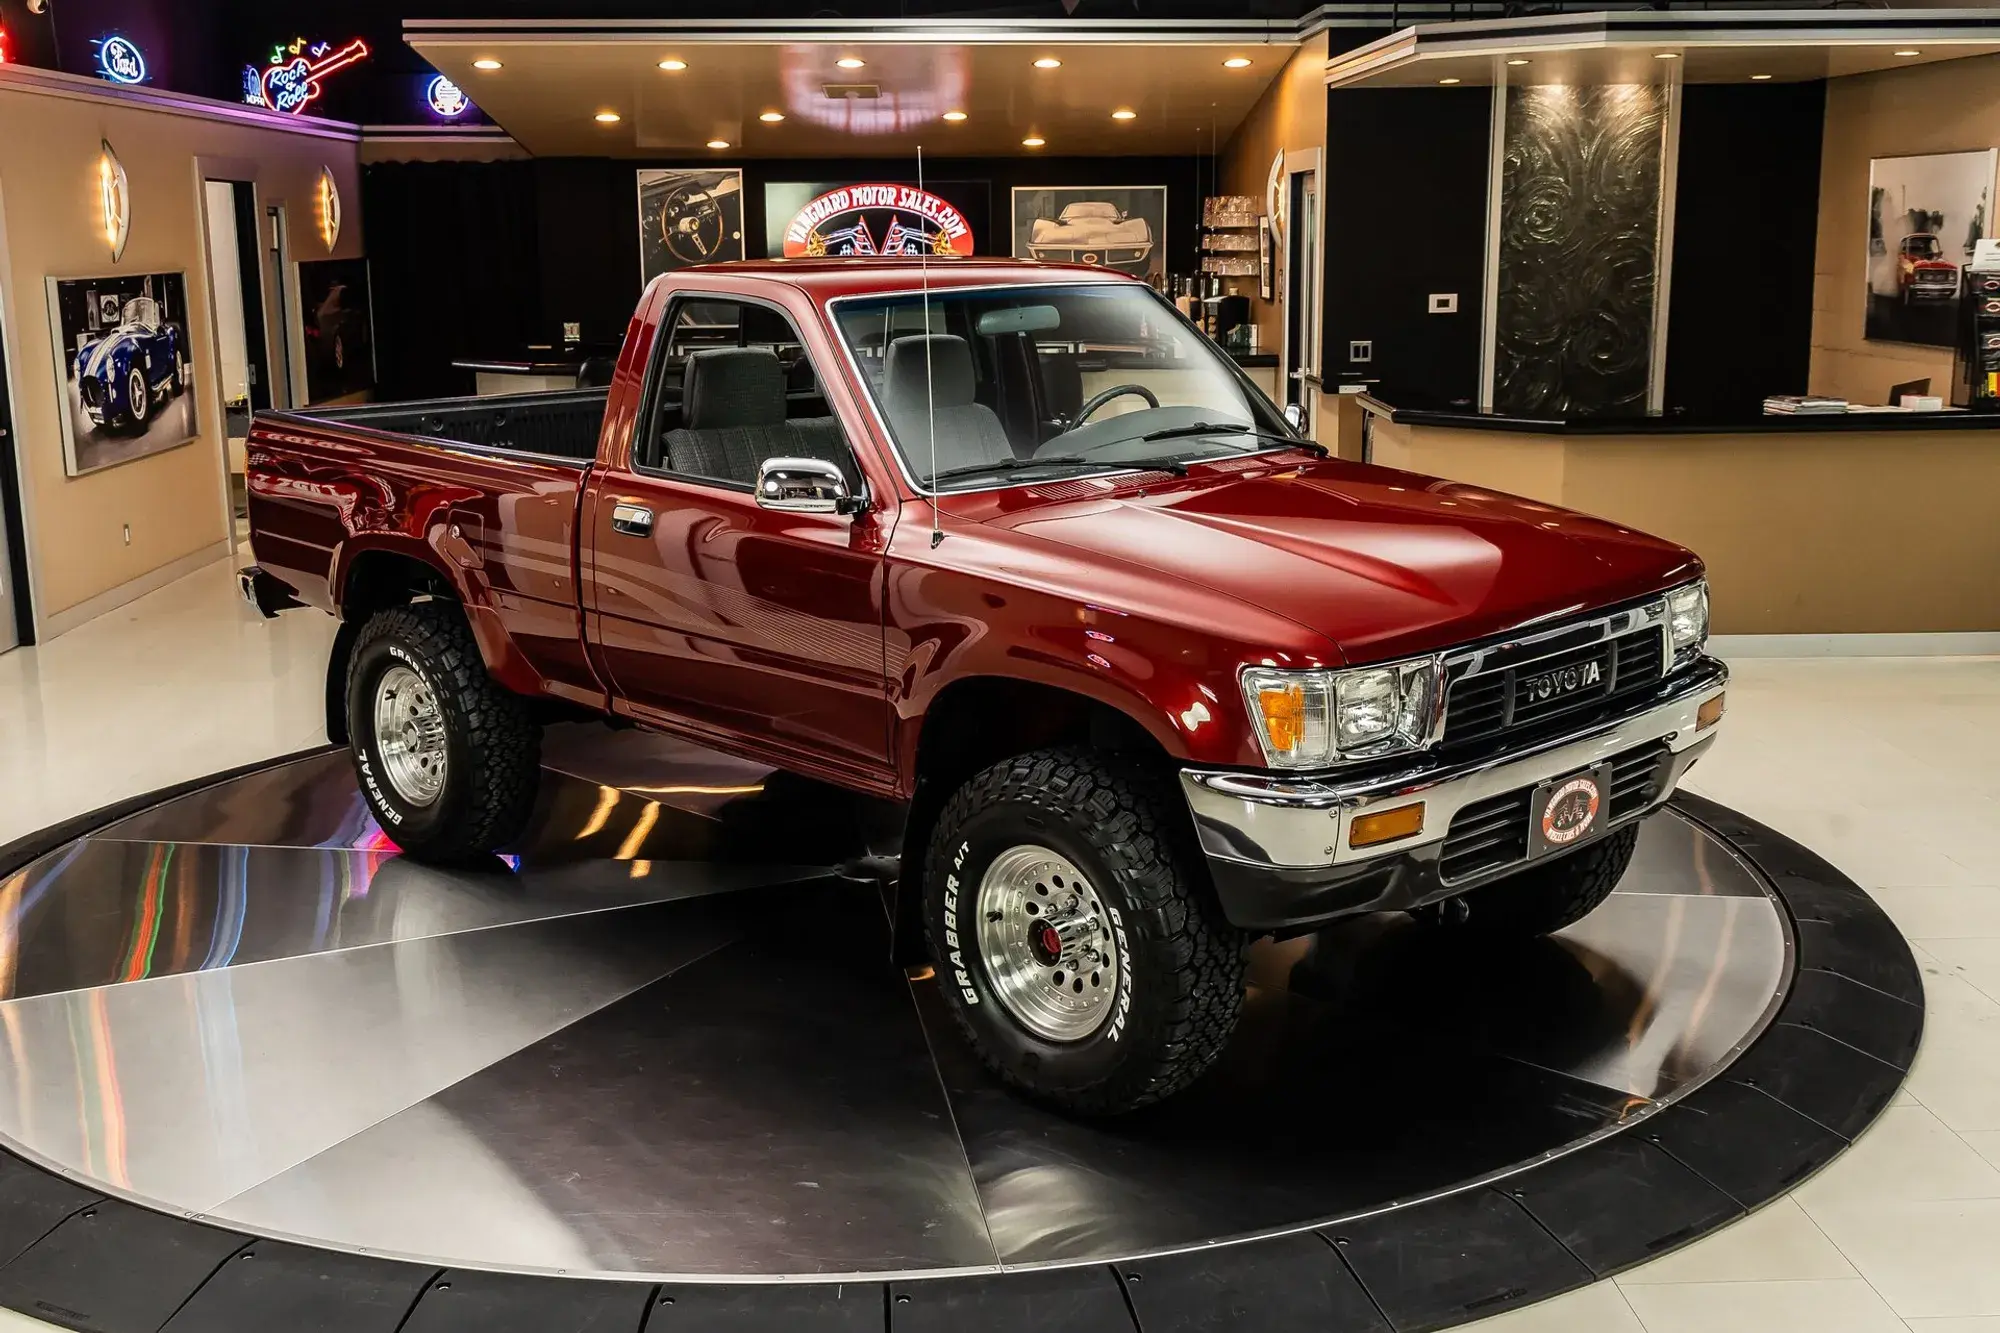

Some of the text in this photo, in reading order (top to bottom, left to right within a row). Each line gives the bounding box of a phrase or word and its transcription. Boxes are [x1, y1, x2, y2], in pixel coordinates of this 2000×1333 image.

[110, 42, 138, 78] Ford
[269, 60, 307, 89] Rock
[276, 82, 308, 111] Roll
[787, 186, 967, 244] VANGUARD MOTOR SALES.COM
[1525, 661, 1600, 702] TOYOTA
[359, 748, 403, 825] GENERAL
[945, 841, 979, 1005] GRABBER A/T
[1107, 907, 1132, 1043] GENERAL
